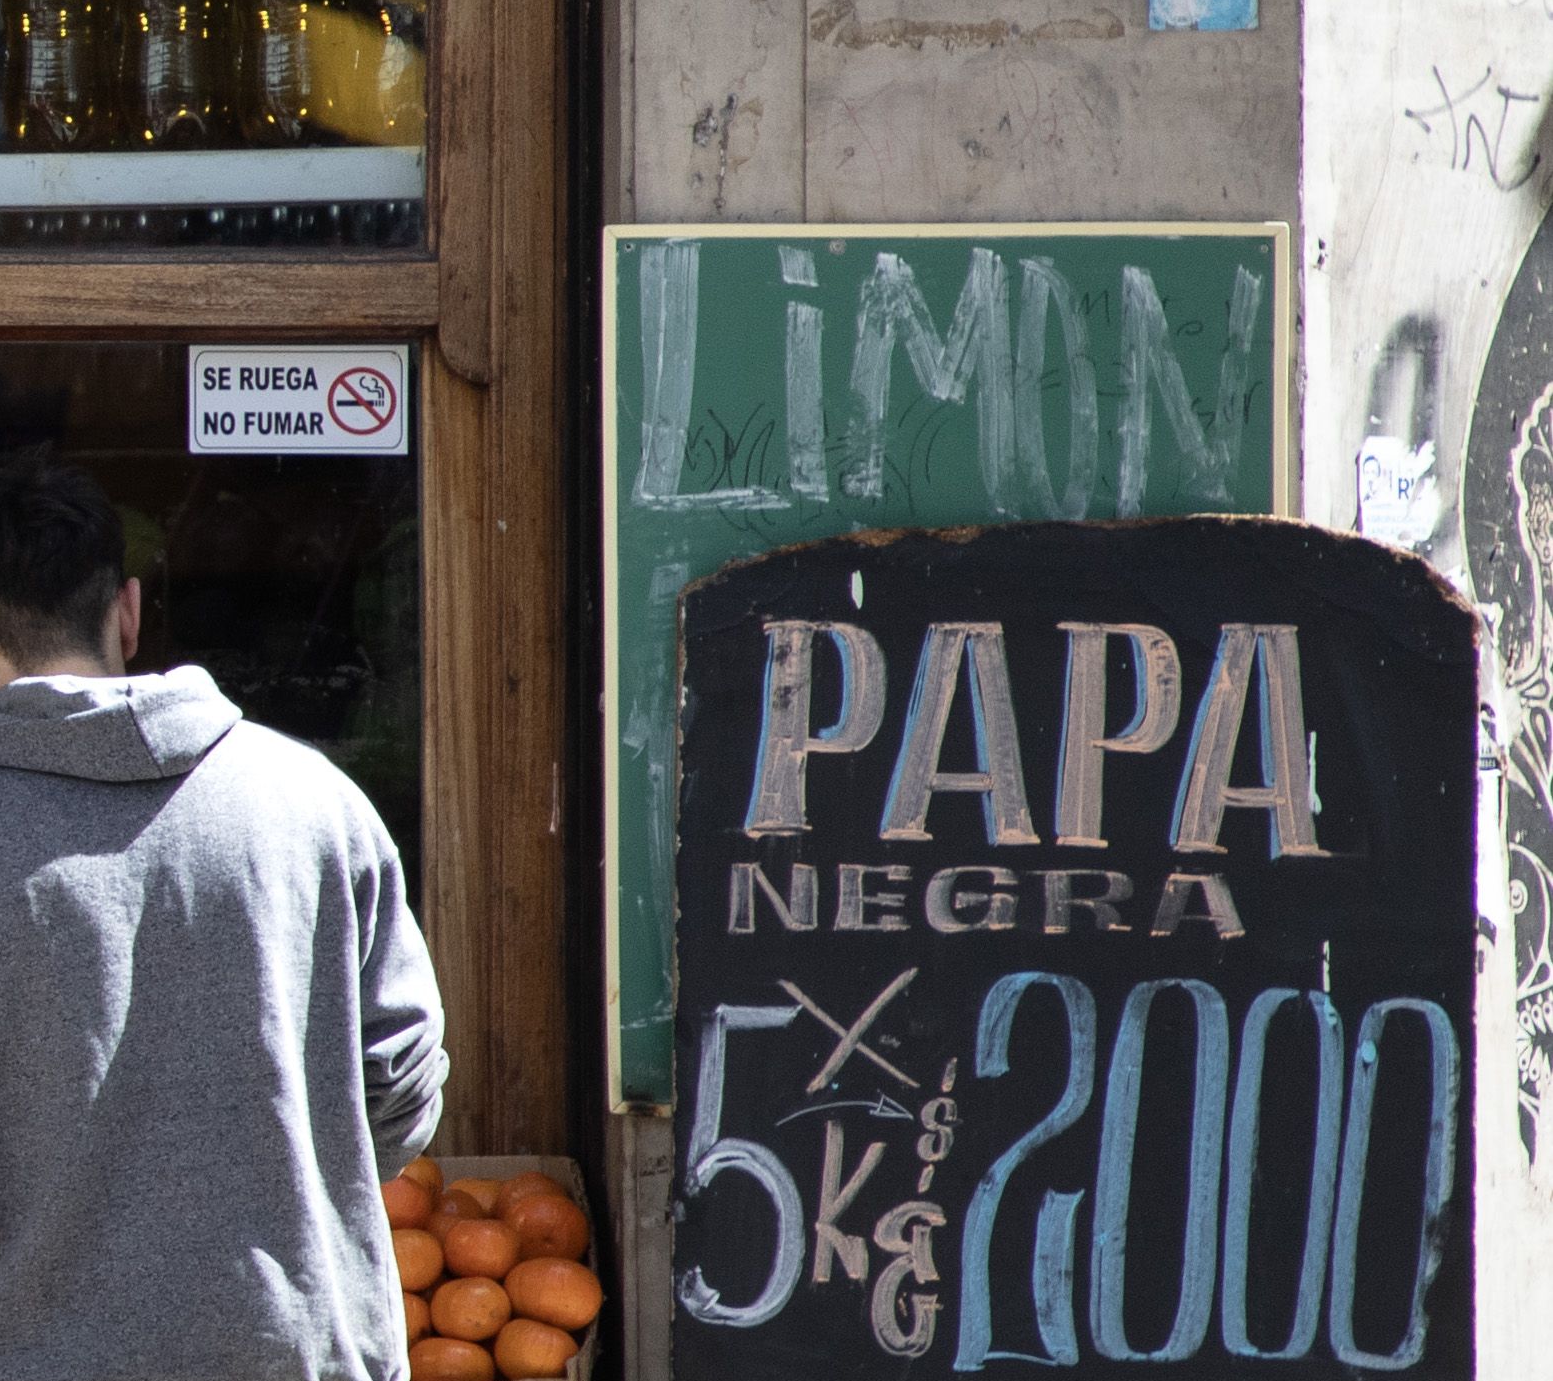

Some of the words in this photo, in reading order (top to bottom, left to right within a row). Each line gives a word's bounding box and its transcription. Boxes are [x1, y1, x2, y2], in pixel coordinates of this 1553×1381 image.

[202, 365, 231, 392] SE
[238, 365, 320, 393] RUEGA
[202, 411, 234, 437] NO
[241, 410, 325, 437] FUMAR
[743, 620, 1336, 860] PAPA
[728, 860, 1247, 941] NEGRA
[677, 1003, 806, 1329] 5
[953, 970, 1462, 1373] 2000
